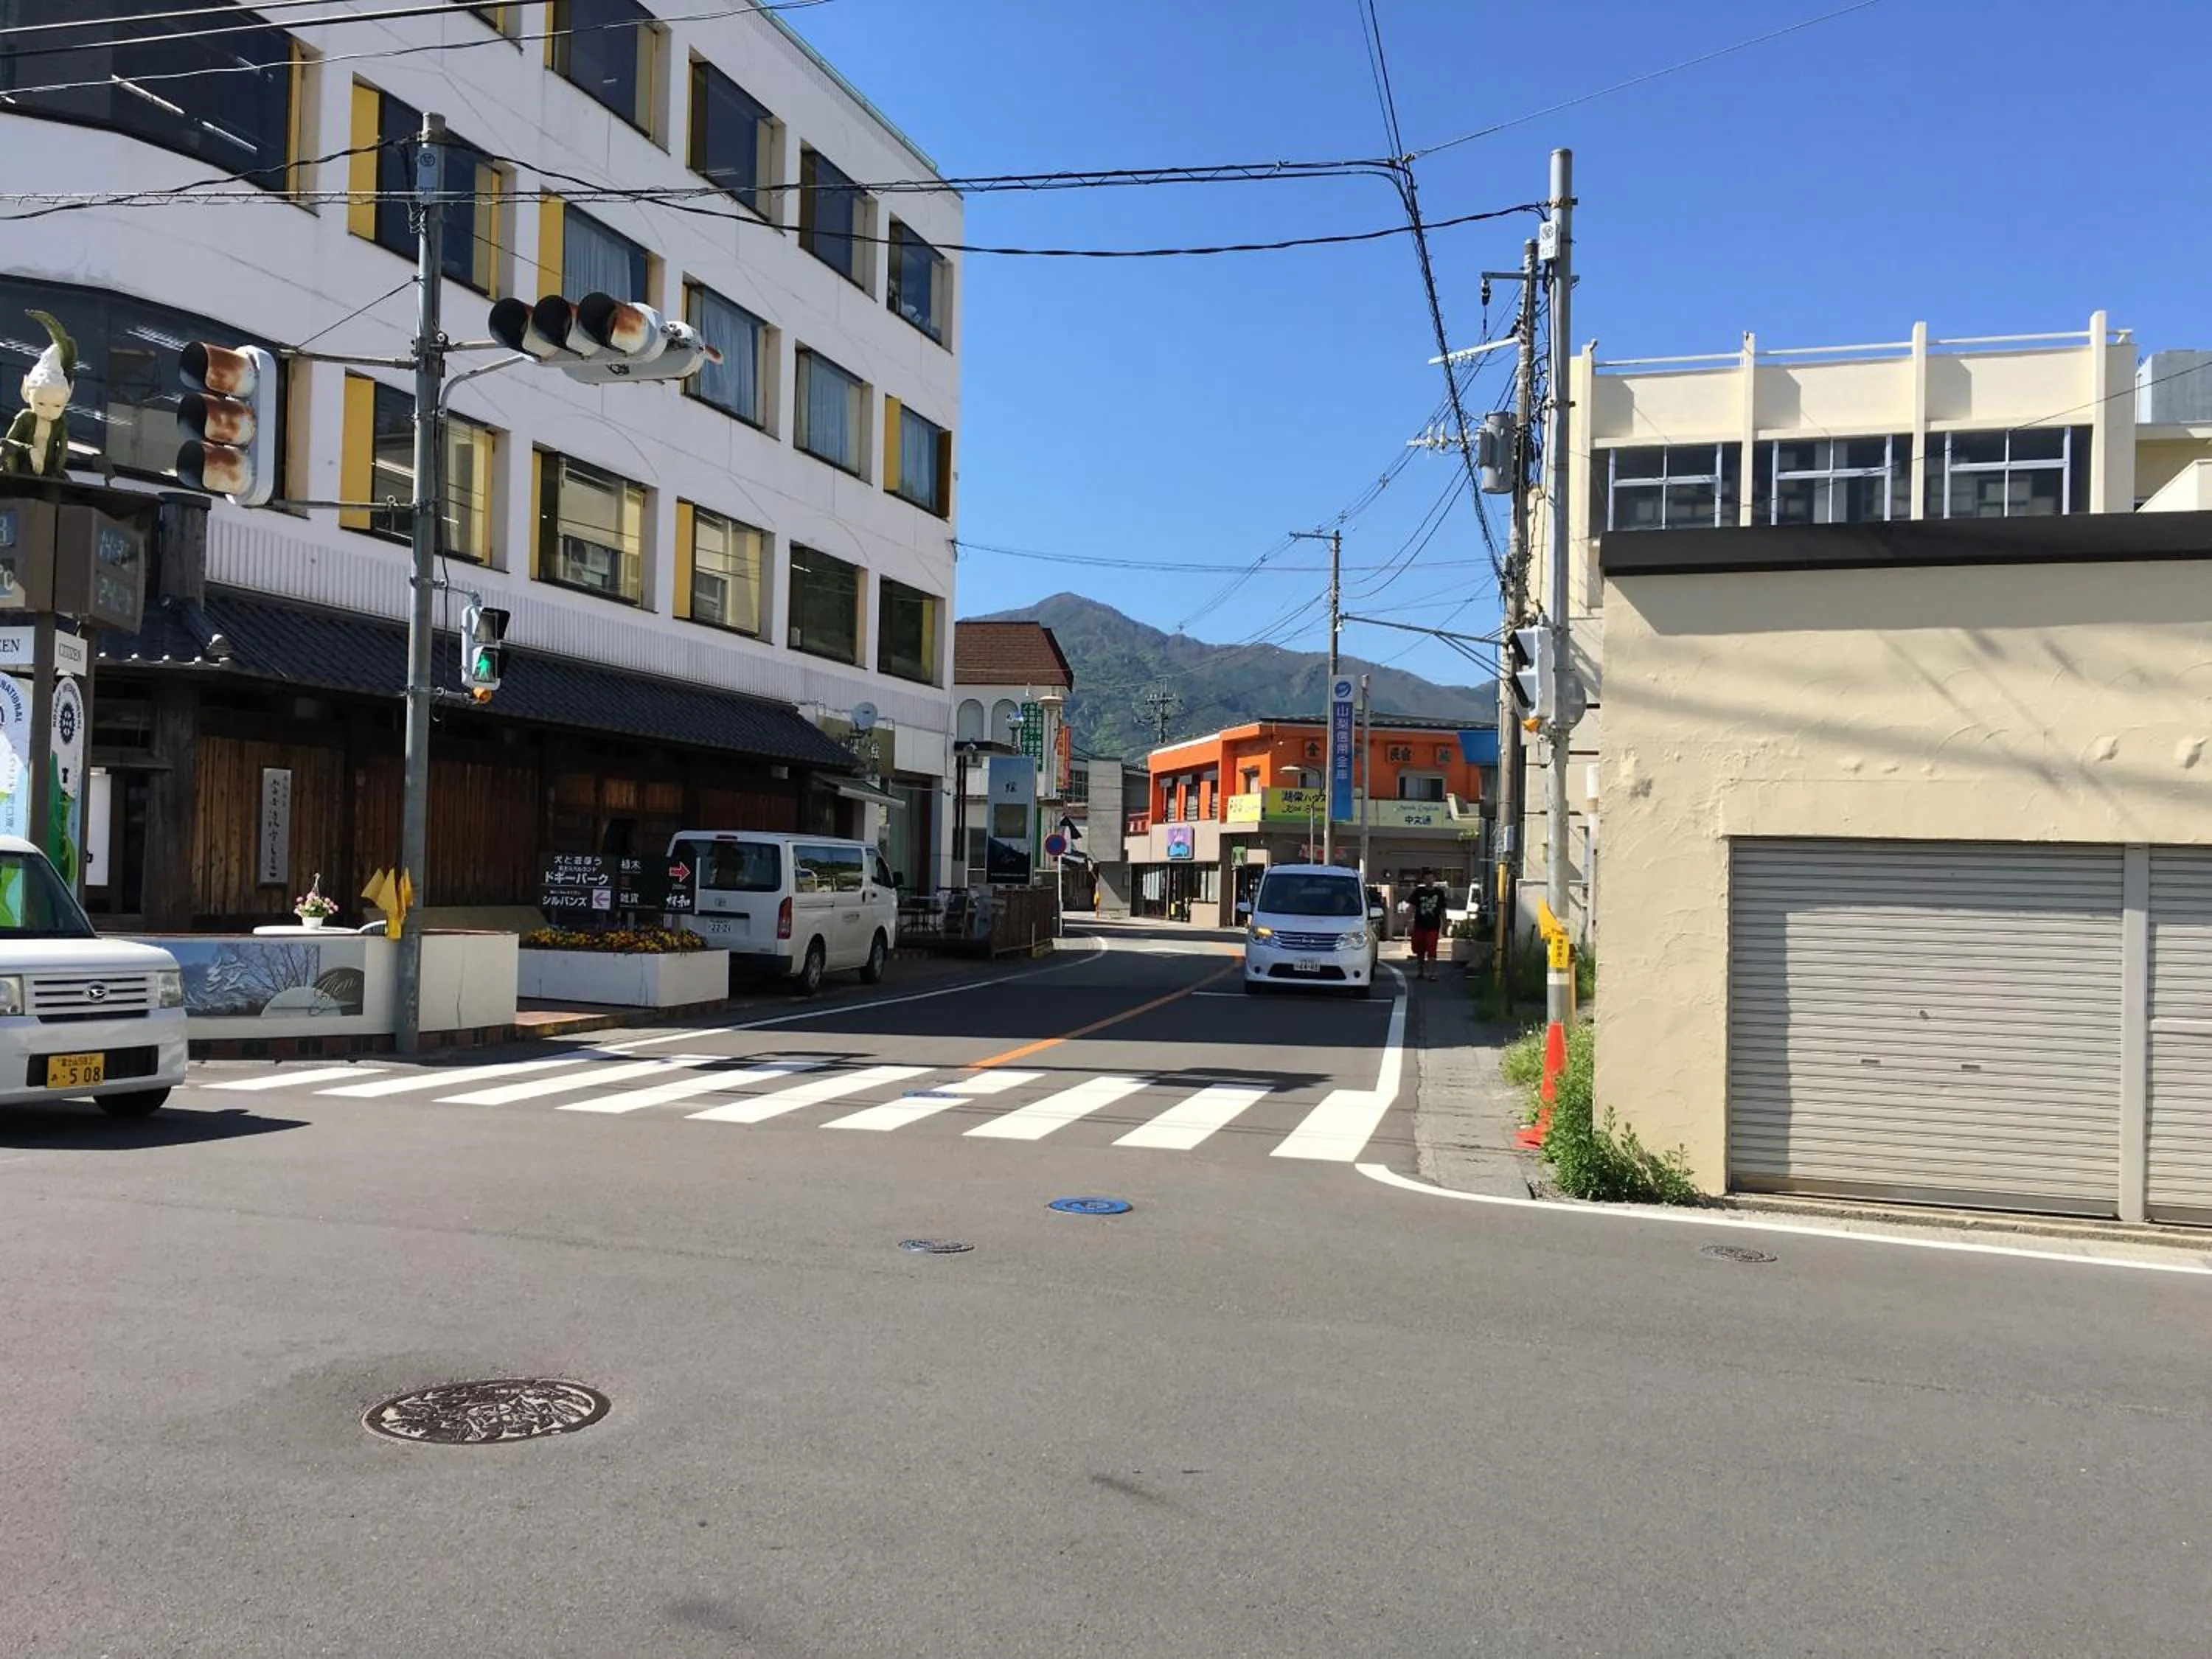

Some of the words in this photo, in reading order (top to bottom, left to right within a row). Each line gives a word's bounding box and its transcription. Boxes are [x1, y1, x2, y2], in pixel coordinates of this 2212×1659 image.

[1336, 704, 1349, 779] 山梨信用金庫
